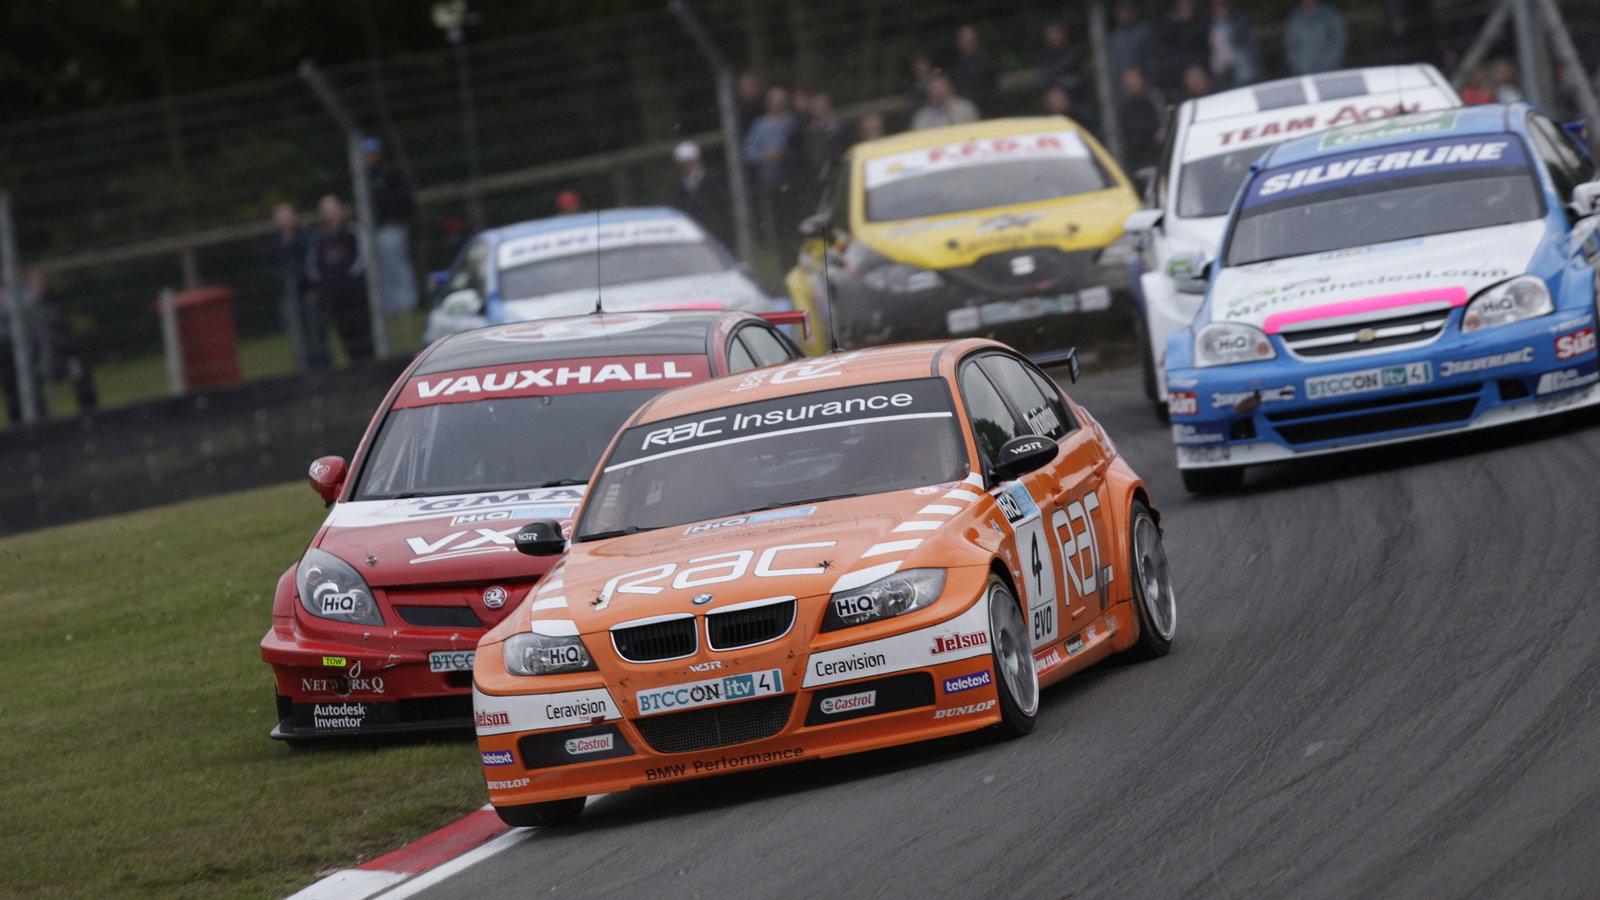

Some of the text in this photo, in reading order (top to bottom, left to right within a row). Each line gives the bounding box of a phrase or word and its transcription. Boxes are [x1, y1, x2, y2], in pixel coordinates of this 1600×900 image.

[1220, 115, 1317, 145] TEAM
[1259, 142, 1508, 196] SILVERLINE
[1482, 298, 1513, 314] HiQ
[1219, 336, 1247, 349] HiQ
[417, 361, 692, 398] VAUXHALL
[1410, 365, 1421, 381] 4
[641, 392, 913, 450] RAC Insurance
[1010, 441, 1043, 455] WSR
[996, 494, 1022, 519] HiQ
[456, 511, 510, 523] HiQ
[692, 518, 747, 533] HiQ
[1051, 491, 1114, 607] RAC
[1031, 530, 1043, 597] 4
[593, 540, 837, 611] RAC
[323, 595, 354, 611] HiQ
[837, 596, 873, 616] HiQ
[1034, 605, 1052, 640] evo
[324, 657, 343, 665] TOW
[550, 647, 579, 665] HiQ
[815, 632, 988, 677] Ceravision Jelson
[688, 661, 723, 672] WSR
[371, 676, 385, 693] Q
[725, 679, 751, 697] itv
[758, 674, 771, 691] 4
[945, 671, 991, 692] teletext
[314, 703, 365, 716] Autodesk
[546, 698, 607, 719] Ceravision
[834, 694, 872, 710] Castrol
[933, 700, 996, 719] DUNLOP
[314, 716, 362, 728] Inventor
[577, 737, 610, 751] Castrol
[645, 747, 804, 781] BMW Performance
[487, 778, 531, 789] DUNLOP
